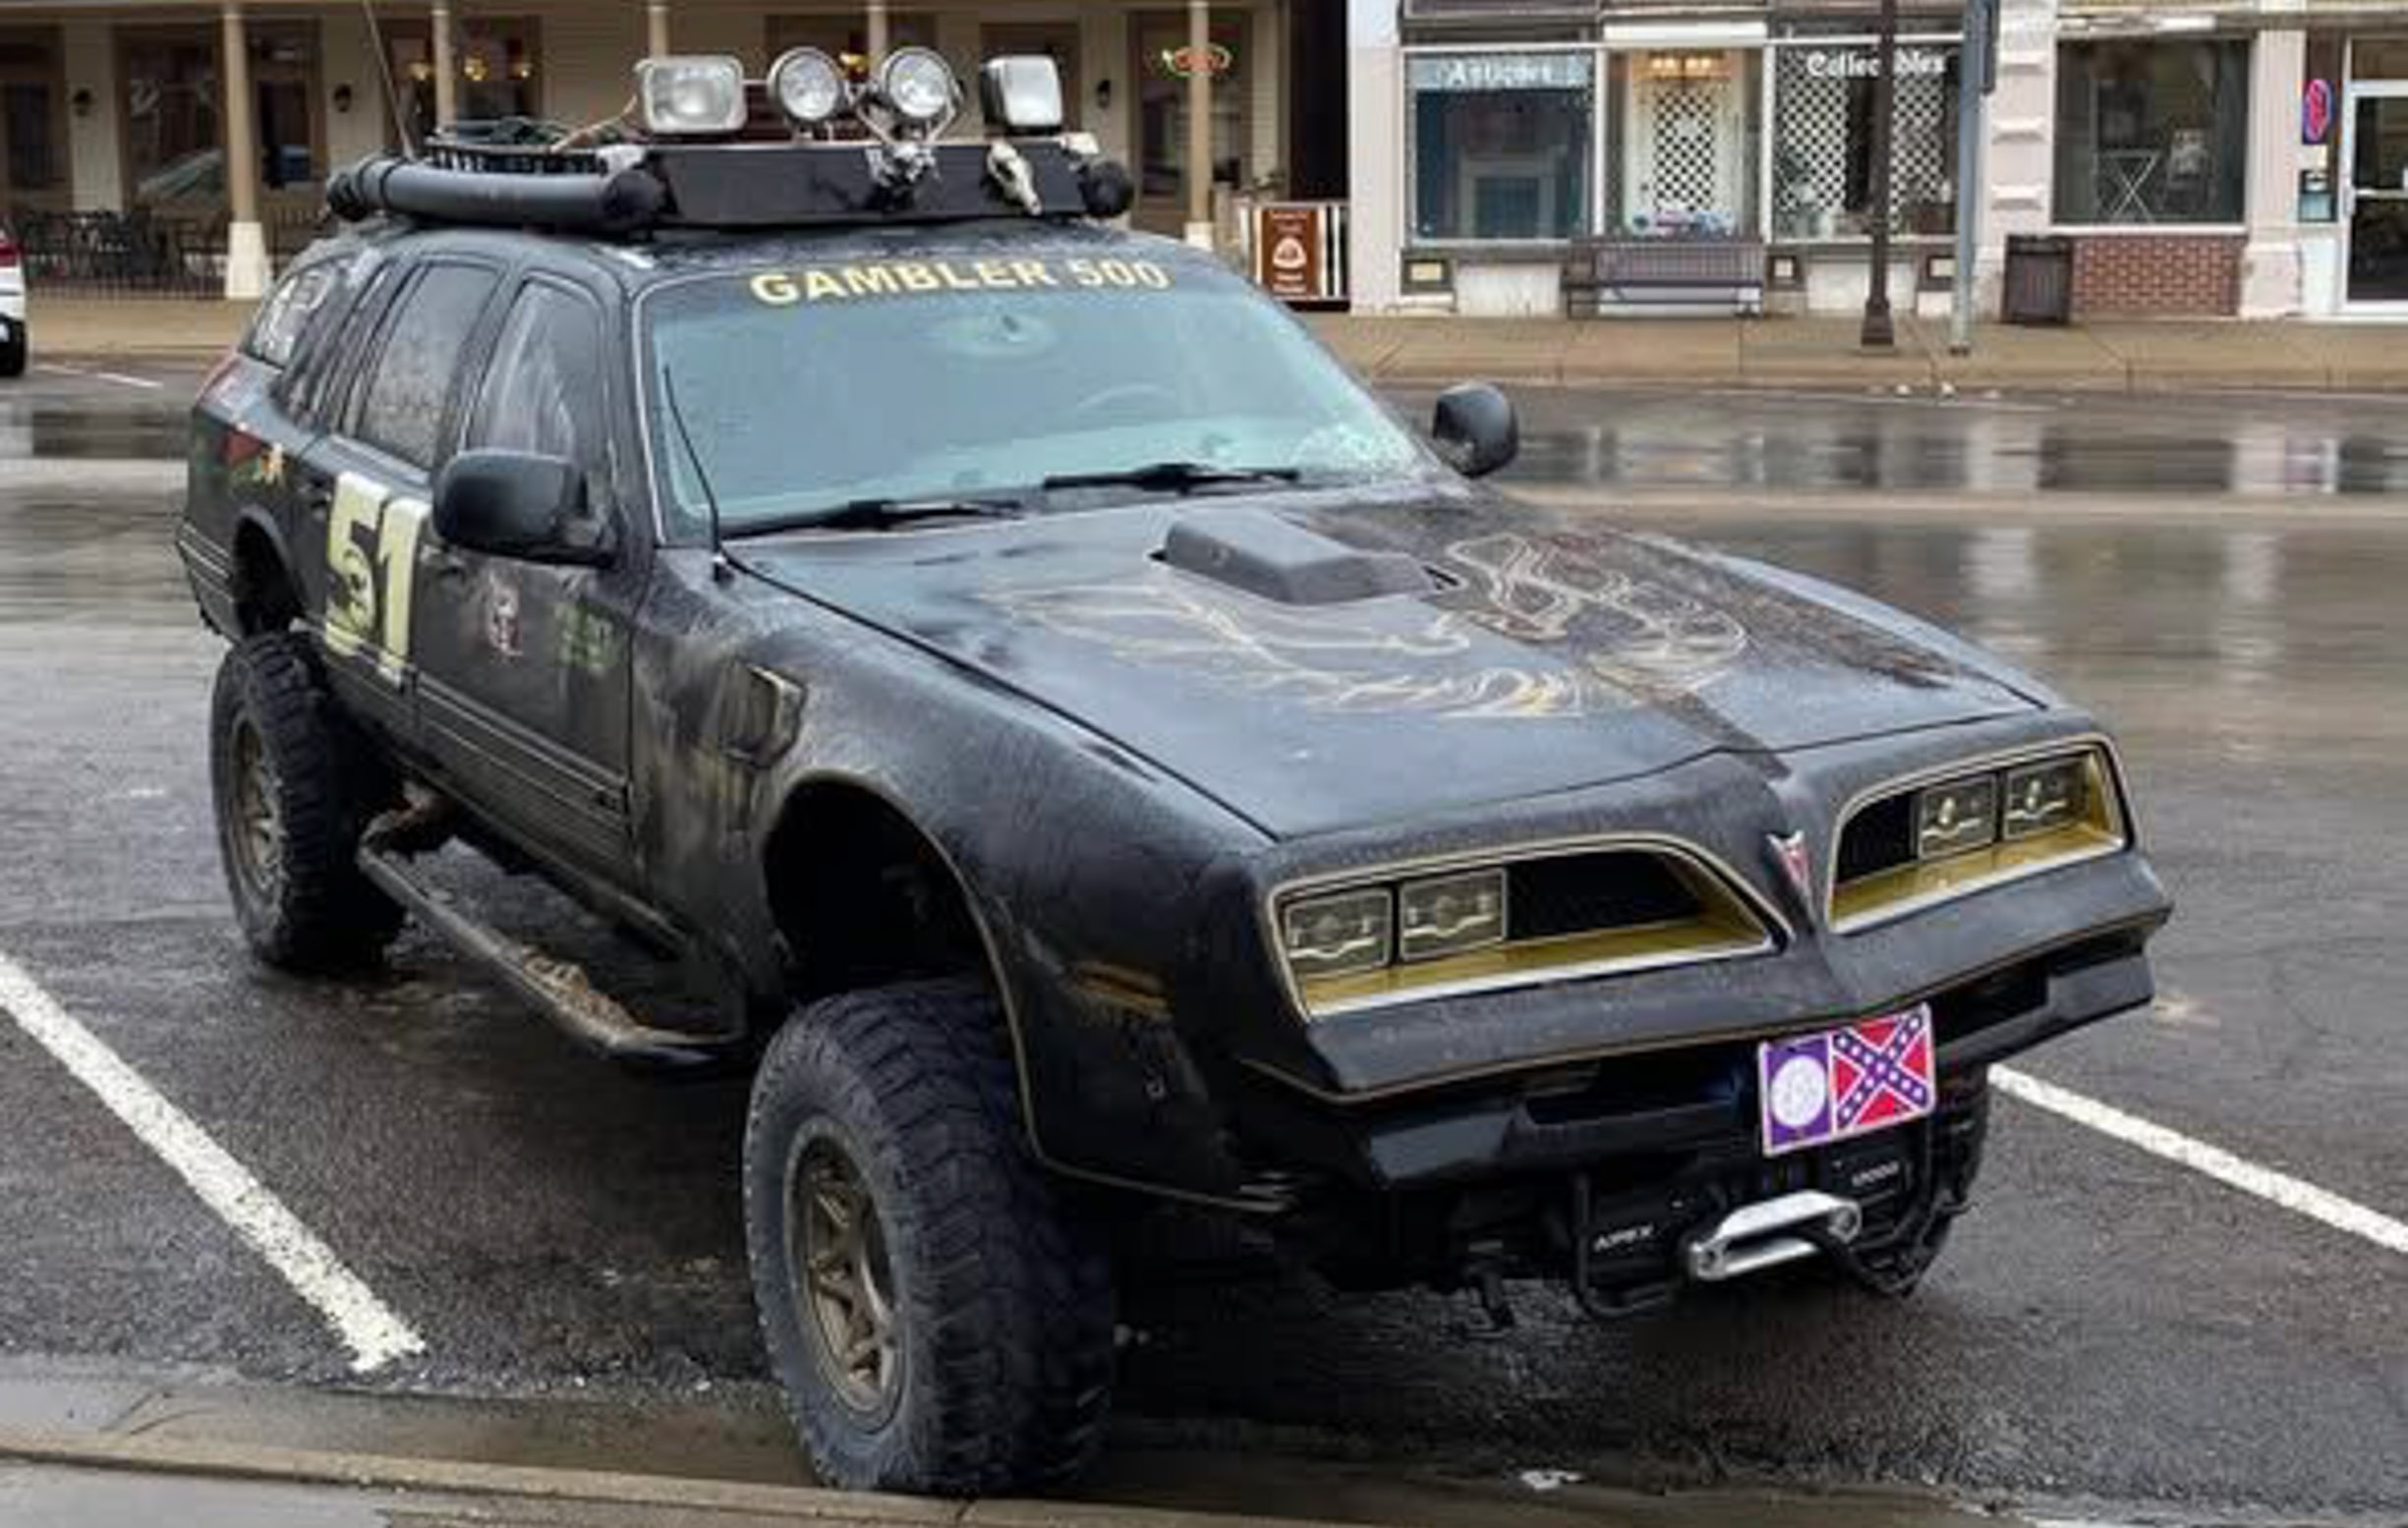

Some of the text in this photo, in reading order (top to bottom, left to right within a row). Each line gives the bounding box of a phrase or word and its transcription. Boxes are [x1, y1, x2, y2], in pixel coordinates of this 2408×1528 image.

[1806, 49, 1945, 78] Collecbles
[750, 257, 1170, 305] GAMBLER 500
[324, 470, 431, 687] 51
